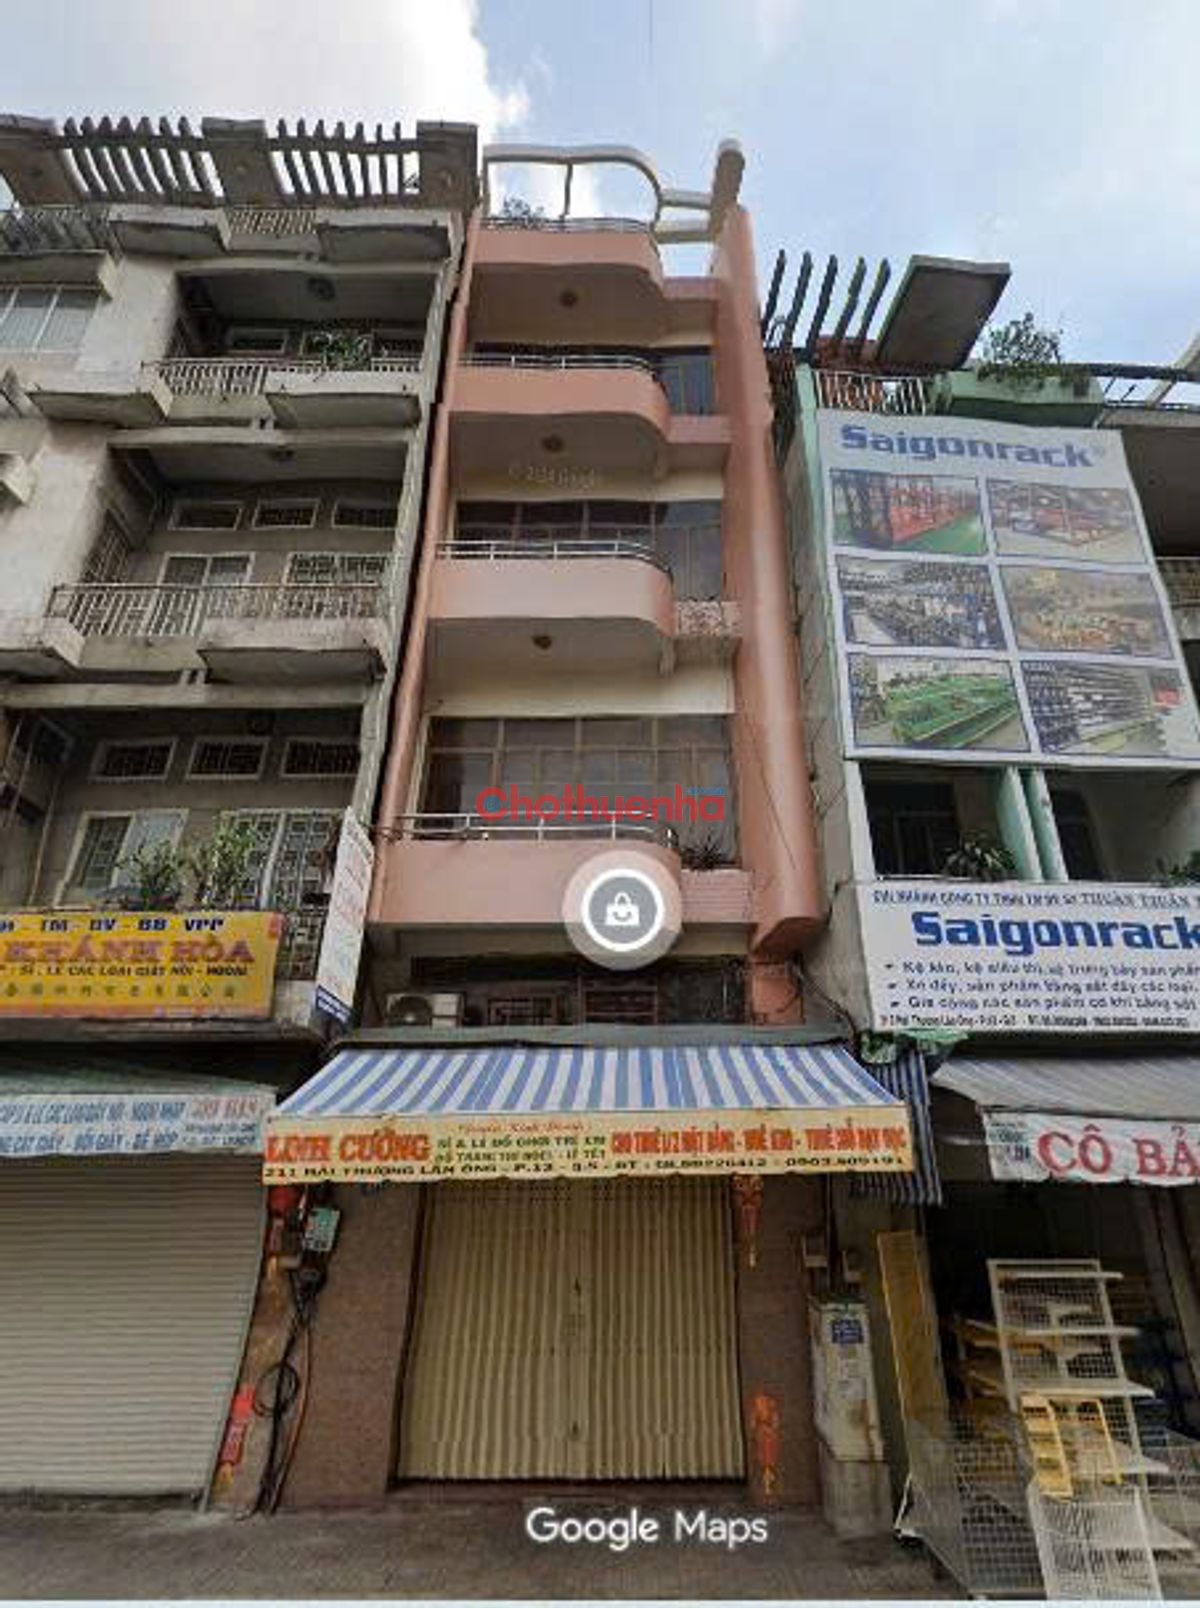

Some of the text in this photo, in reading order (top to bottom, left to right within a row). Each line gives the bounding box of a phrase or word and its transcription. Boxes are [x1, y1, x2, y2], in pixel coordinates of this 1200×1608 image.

[840, 424, 1094, 467] Saigonrack
[911, 911, 1200, 956] Saigonrack
[1038, 1124, 1112, 1174] CÔ
[1132, 1125, 1200, 1178] BẢ
